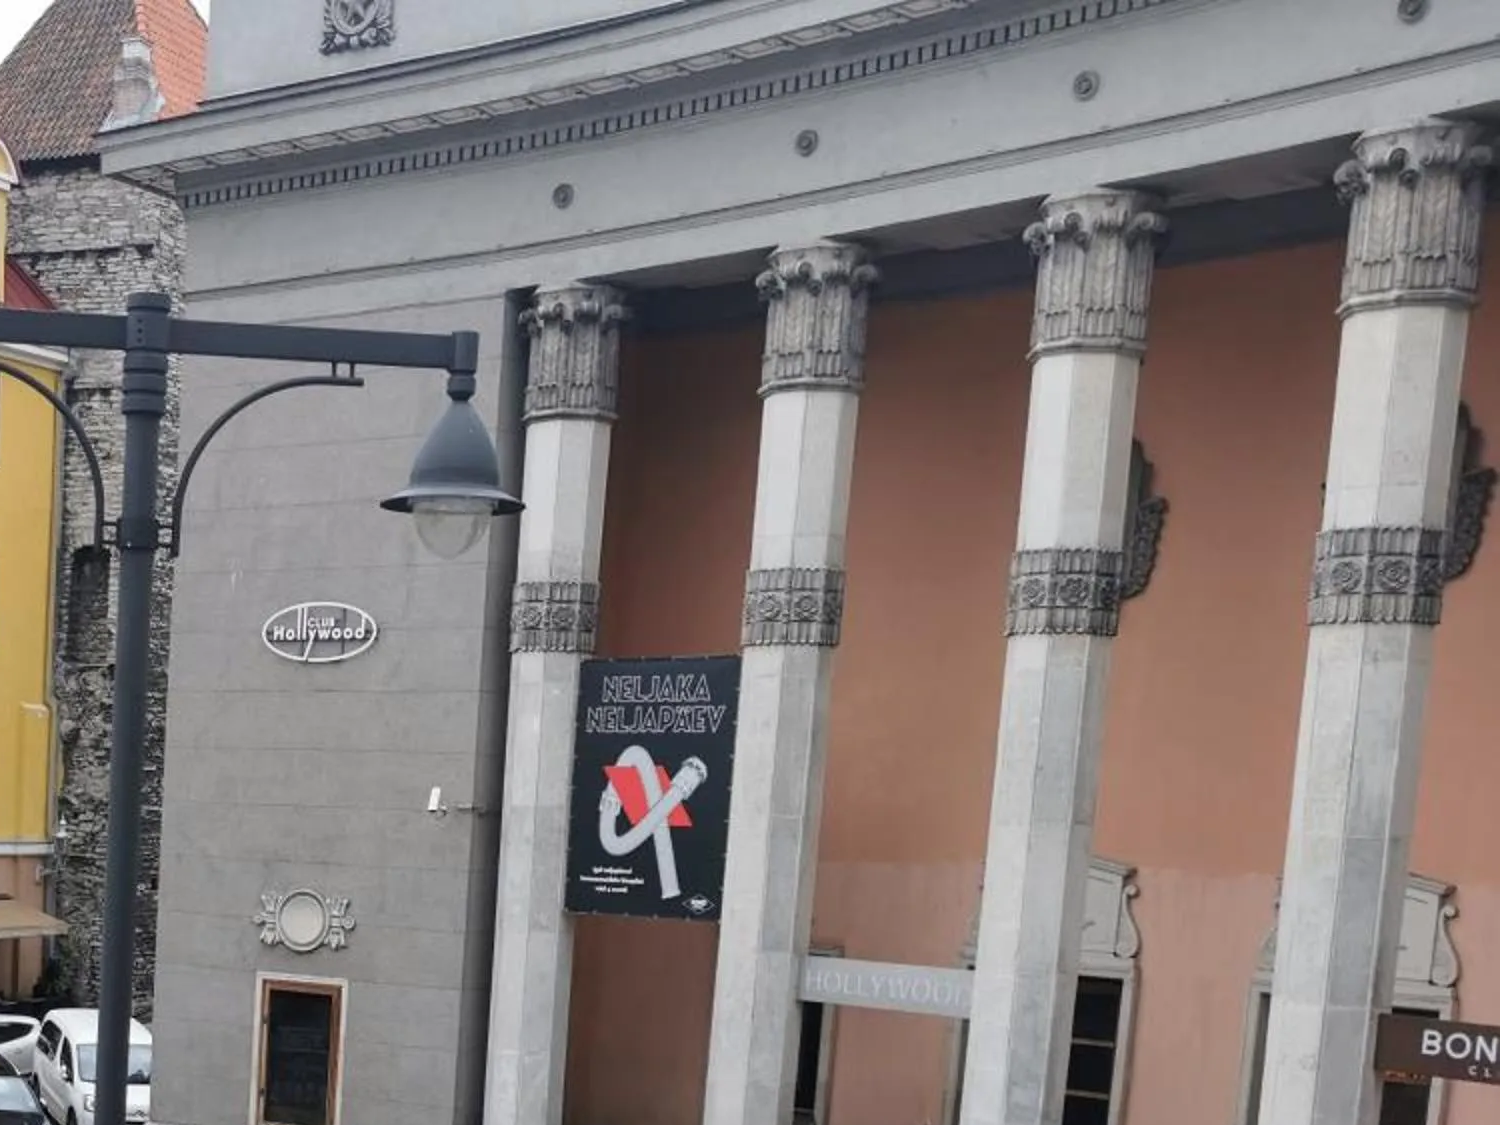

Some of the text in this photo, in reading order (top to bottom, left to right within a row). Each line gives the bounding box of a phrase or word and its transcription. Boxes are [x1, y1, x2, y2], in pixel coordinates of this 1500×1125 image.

[308, 617, 335, 628] CLUB
[602, 674, 711, 702] NELJAKA
[585, 704, 727, 733] NELJAPÄEV
[1421, 1028, 1499, 1063] BON
